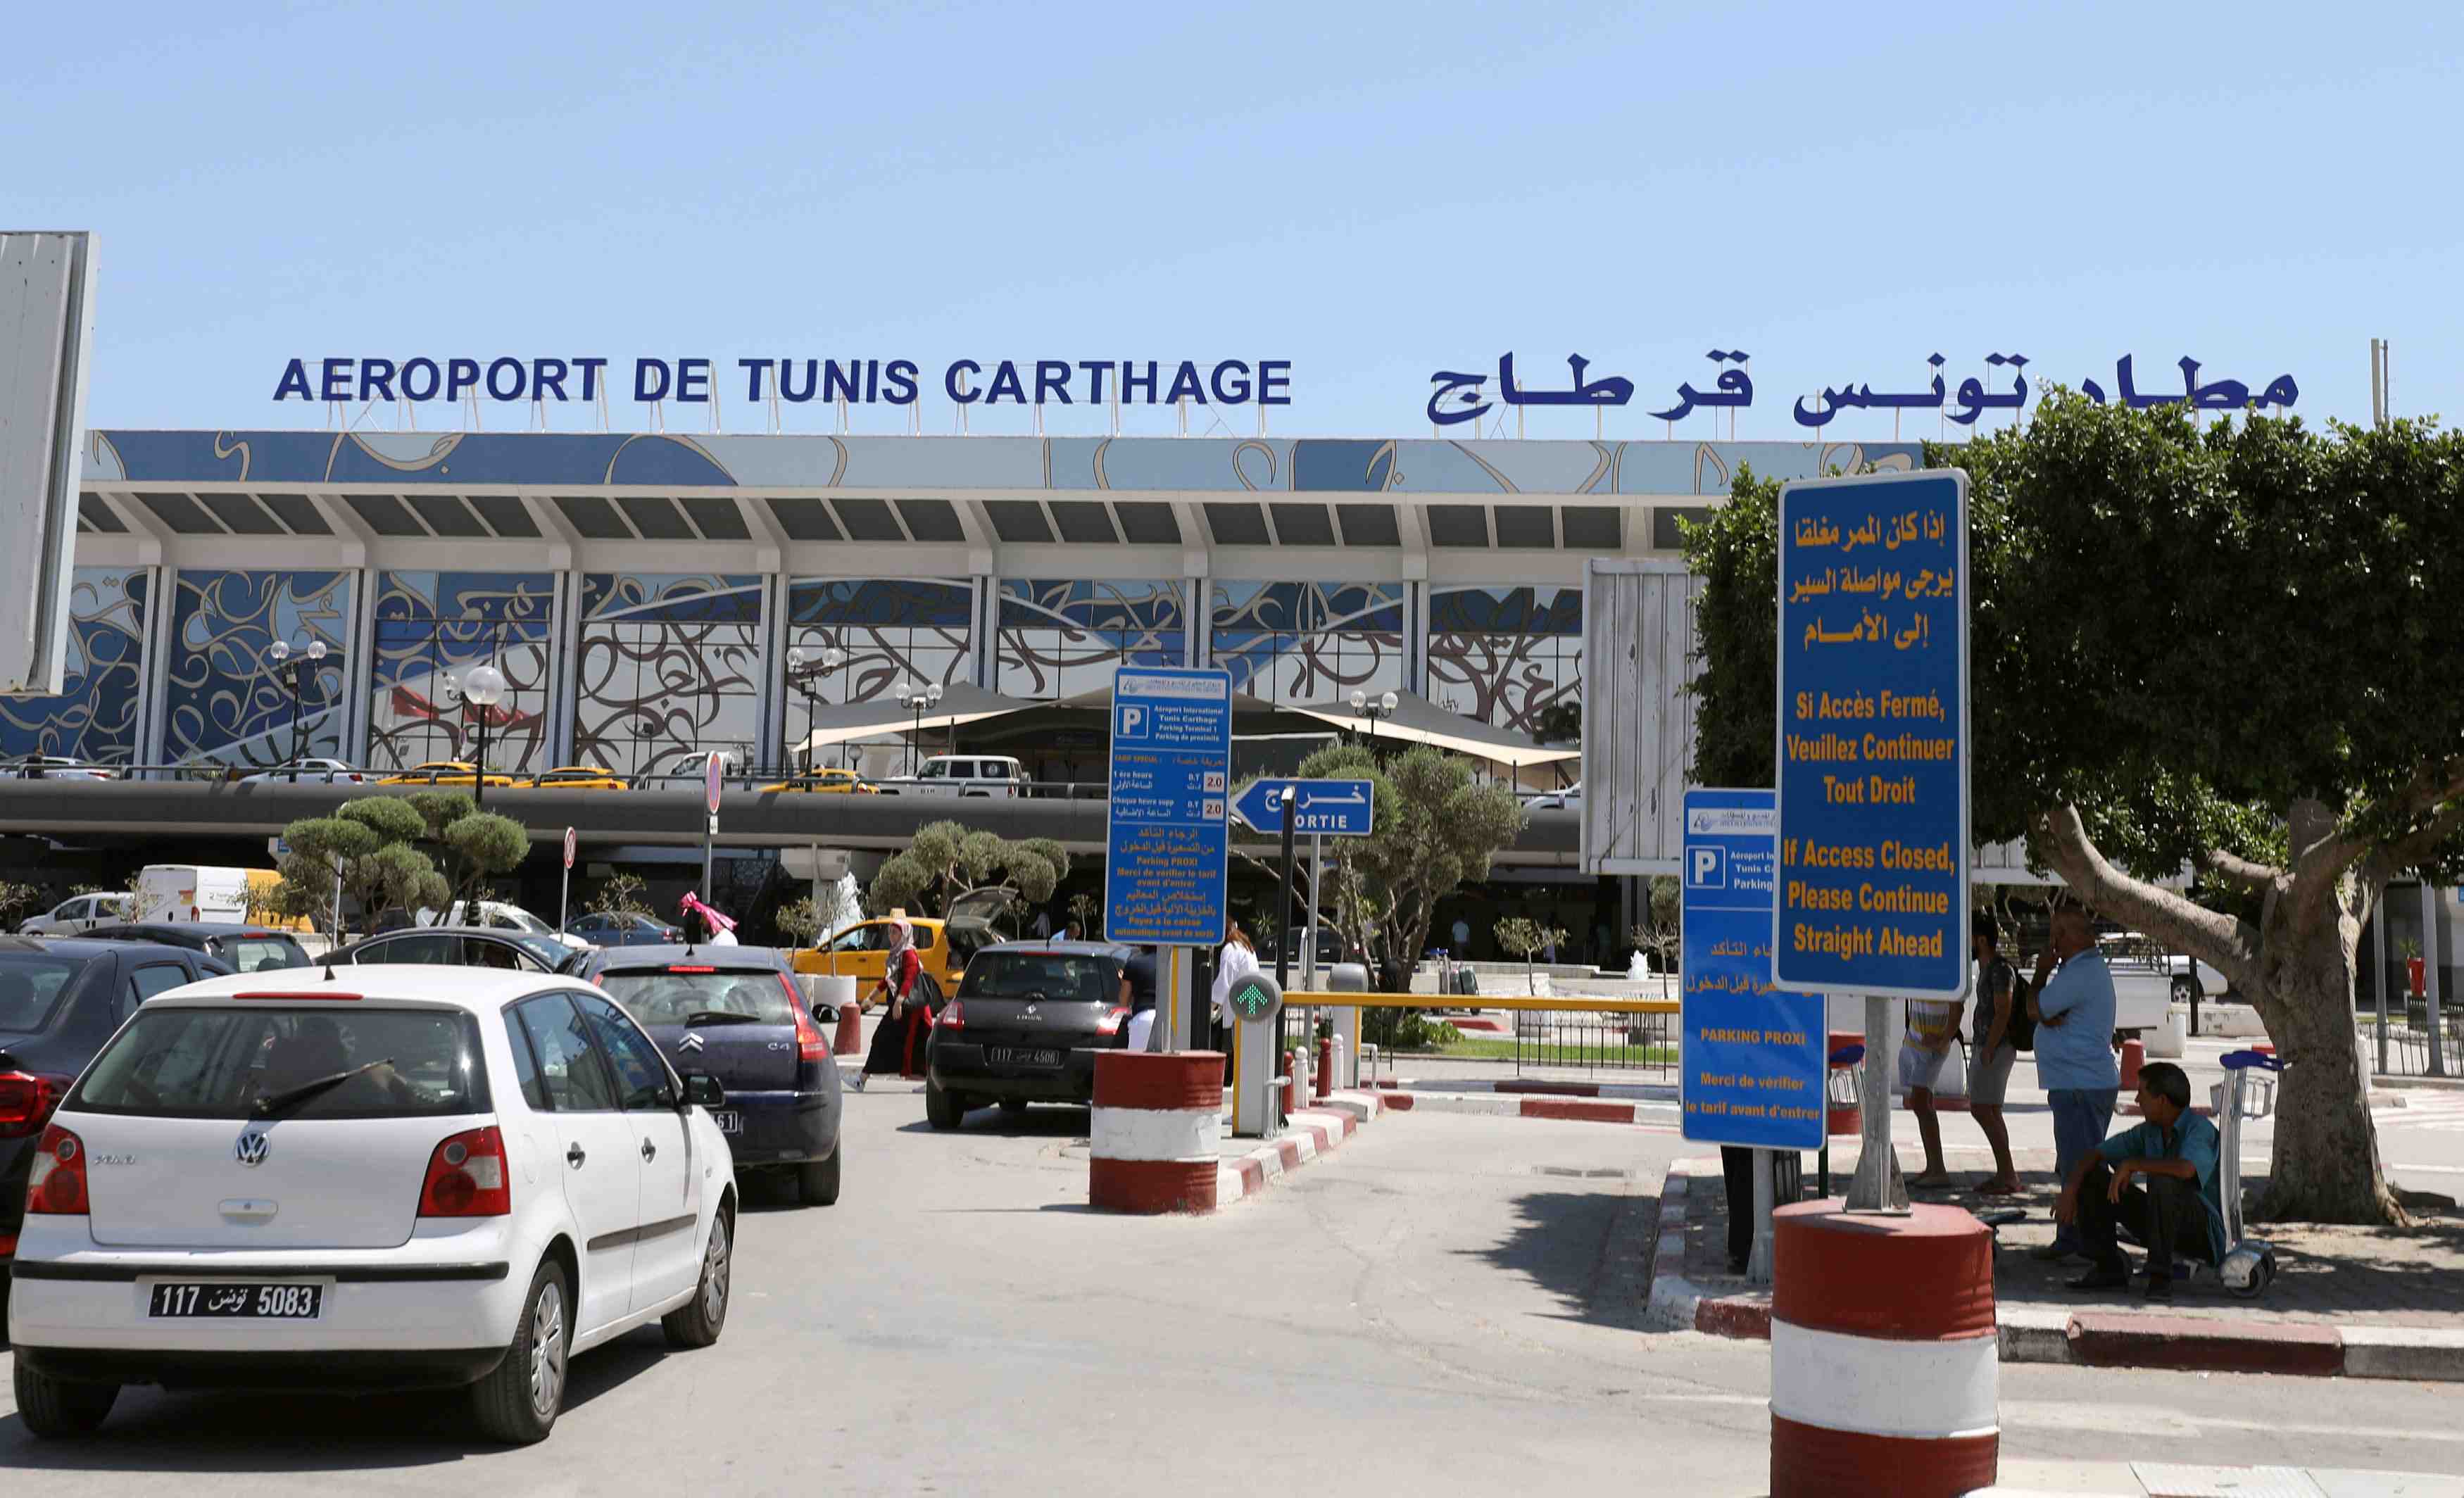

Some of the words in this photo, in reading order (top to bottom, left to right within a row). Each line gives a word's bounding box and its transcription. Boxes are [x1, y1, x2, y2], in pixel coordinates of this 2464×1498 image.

[273, 357, 608, 402] AEROPORT
[634, 358, 710, 402] DE
[738, 358, 919, 405] TUNIS
[945, 359, 1291, 405] CARTHAGE
[1427, 350, 1754, 425] قرطاج
[1794, 352, 2030, 427] تونس
[1795, 515, 1840, 548] مغلقا
[1885, 510, 1918, 550] كان
[1923, 509, 1946, 547] إذا
[1787, 566, 1837, 603] السير
[1840, 563, 1901, 600] مواصلة
[1904, 566, 1954, 599] يرجى
[1894, 611, 1929, 650] إلى
[1123, 707, 1142, 734] P
[1182, 716, 1217, 725] Carthage
[1796, 691, 1814, 719] Si
[1818, 689, 1875, 719] Accès
[1880, 688, 1945, 723] Fermé,
[1787, 733, 1857, 762] Veuillez
[1863, 732, 1954, 762] Continuer
[1207, 777, 1223, 788] 2.0
[1264, 783, 1366, 813] خرج
[1824, 775, 1863, 804] Tout
[1870, 775, 1915, 804] Droit
[1205, 804, 1222, 814] 2.0
[1294, 814, 1347, 829] ORTIE
[1136, 855, 1169, 867] Parking
[1171, 857, 1198, 867] PROXI
[1695, 850, 1717, 885] P
[1735, 864, 1761, 874] Tunis
[1784, 838, 1798, 867] If
[1802, 838, 1875, 869] Access
[1880, 840, 1955, 876] Closed,
[1734, 878, 1773, 893] Parking
[1787, 880, 1853, 910] Please
[1859, 882, 1949, 914] Continue
[1794, 923, 1873, 961] Straight
[1878, 927, 1943, 957] Ahead
[1700, 1028, 1761, 1045] PARKING
[1764, 1030, 1806, 1045] PROXI
[1700, 1072, 1735, 1086] Merci
[1740, 1073, 1754, 1088] de
[1685, 1100, 1697, 1113] le
[1701, 1101, 1727, 1114] tarif
[1730, 1103, 1765, 1117] avant
[1768, 1104, 1820, 1120] d'entrer
[161, 1285, 201, 1315] 117
[208, 1288, 249, 1313] تونس
[256, 1285, 314, 1316] 5083
